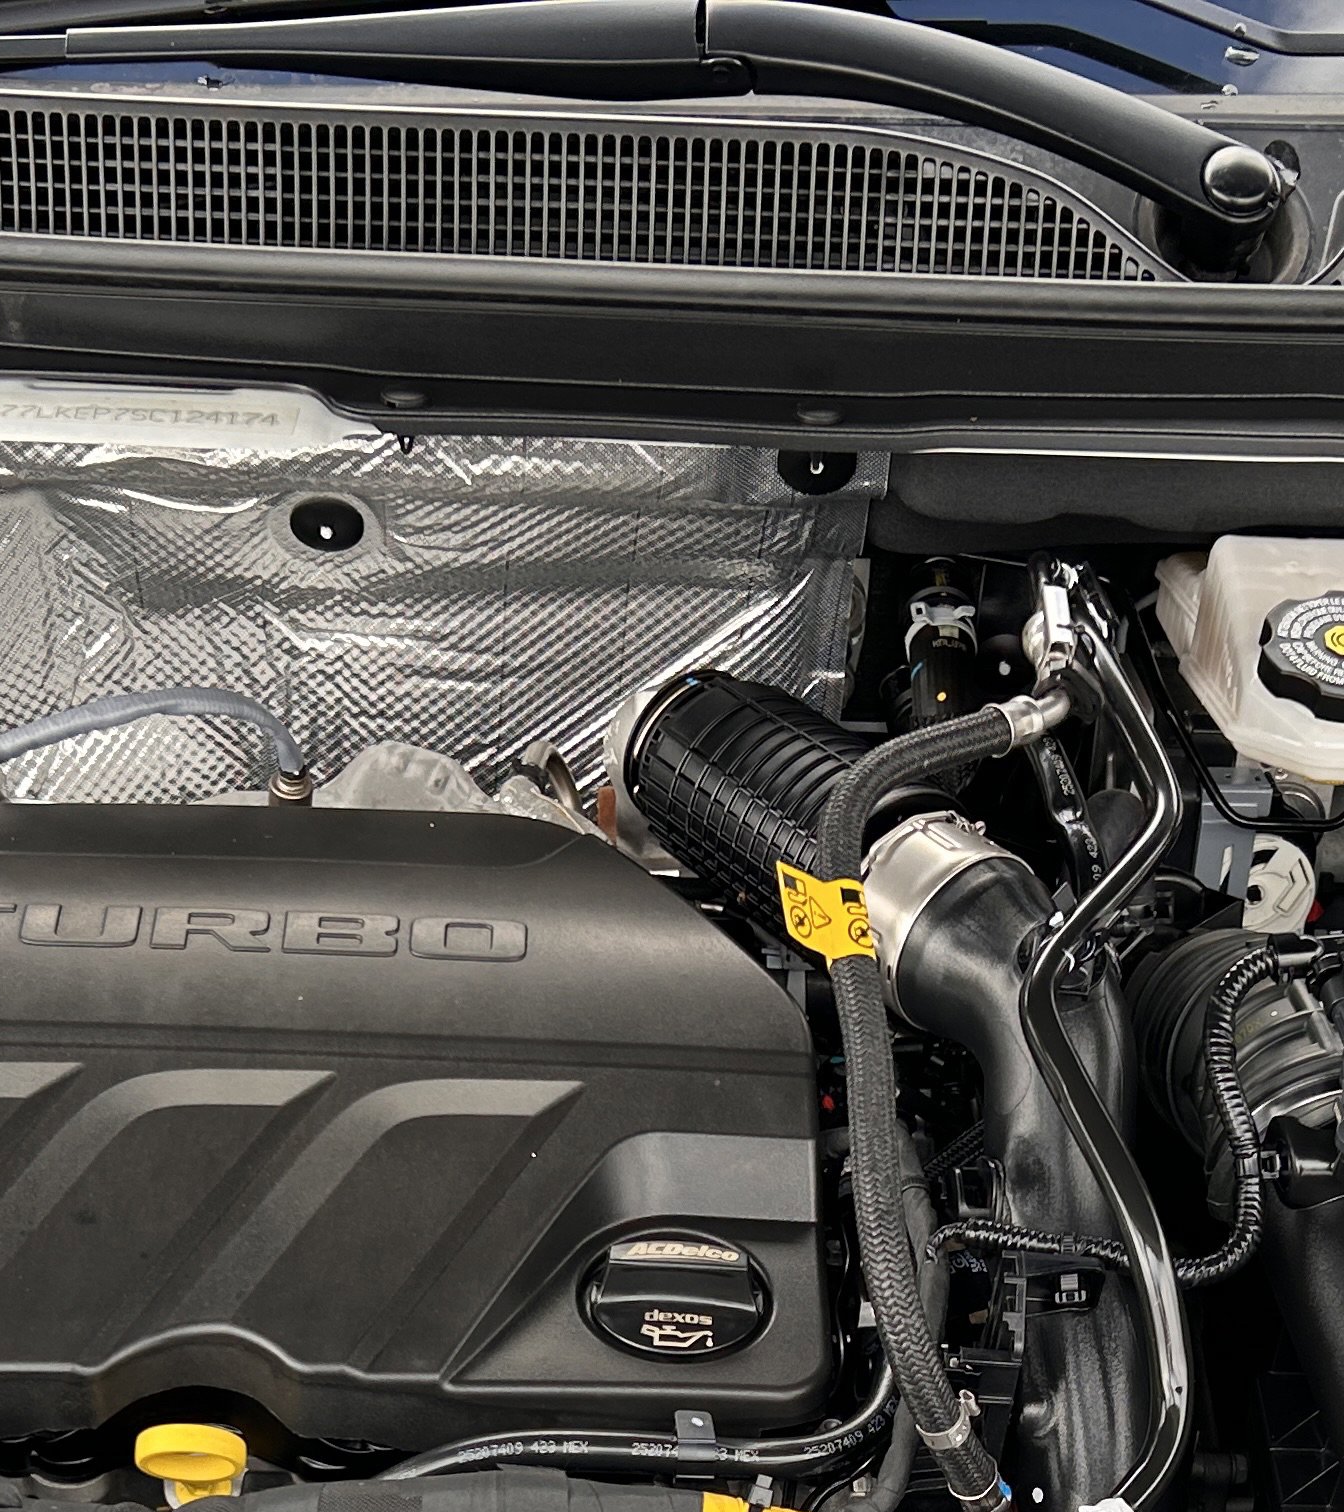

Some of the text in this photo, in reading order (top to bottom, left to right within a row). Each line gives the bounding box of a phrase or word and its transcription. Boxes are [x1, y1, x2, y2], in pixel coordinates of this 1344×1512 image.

[1316, 671, 1344, 686] FROM
[626, 1241, 740, 1262] ACDelco
[644, 1308, 713, 1325] dexos
[562, 1440, 589, 1454] MEX
[803, 1430, 864, 1455] 25207409
[734, 1449, 760, 1463] MEX
